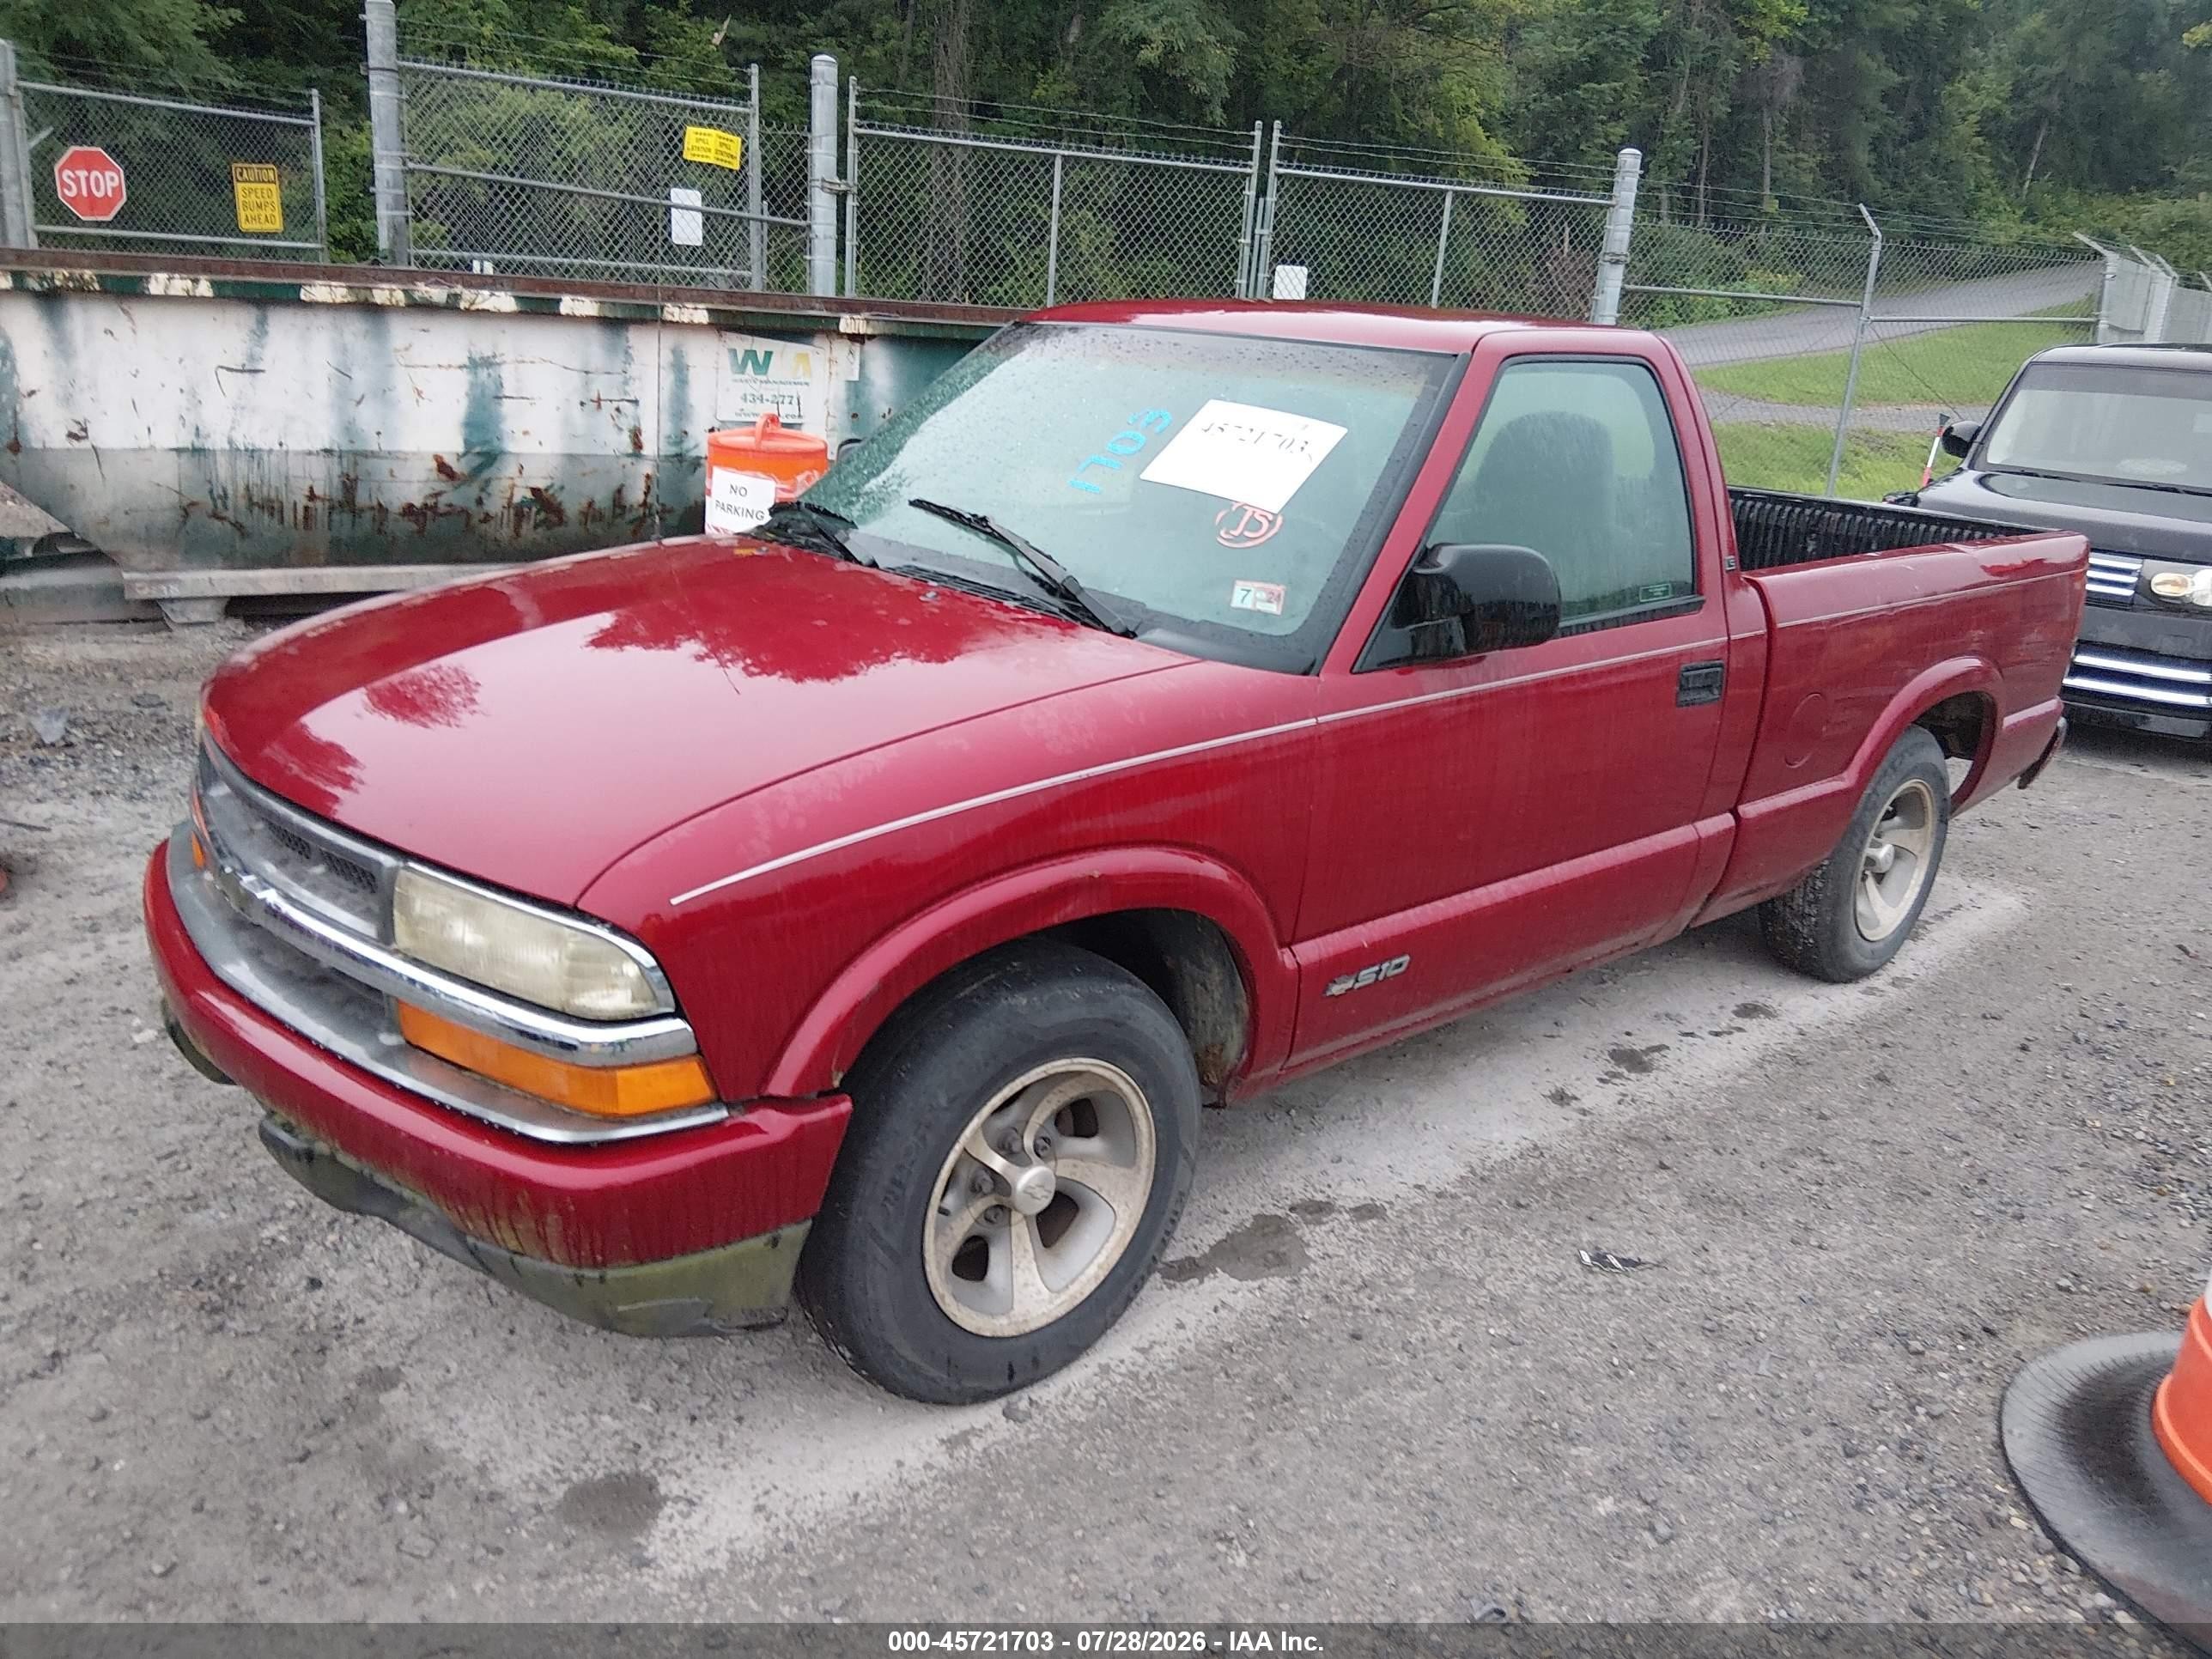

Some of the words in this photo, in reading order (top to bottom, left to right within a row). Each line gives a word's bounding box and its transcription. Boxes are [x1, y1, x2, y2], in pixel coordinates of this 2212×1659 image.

[236, 167, 275, 182] CAUTION
[62, 168, 119, 198] STOP
[241, 186, 273, 199] SPEED
[242, 200, 276, 212] BUMPS
[245, 214, 276, 225] AHEAD
[1068, 407, 1173, 494] 1703
[730, 483, 747, 497] NO
[715, 500, 765, 520] PARKING
[1240, 588, 1251, 603] 7
[1353, 954, 1410, 989] S10
